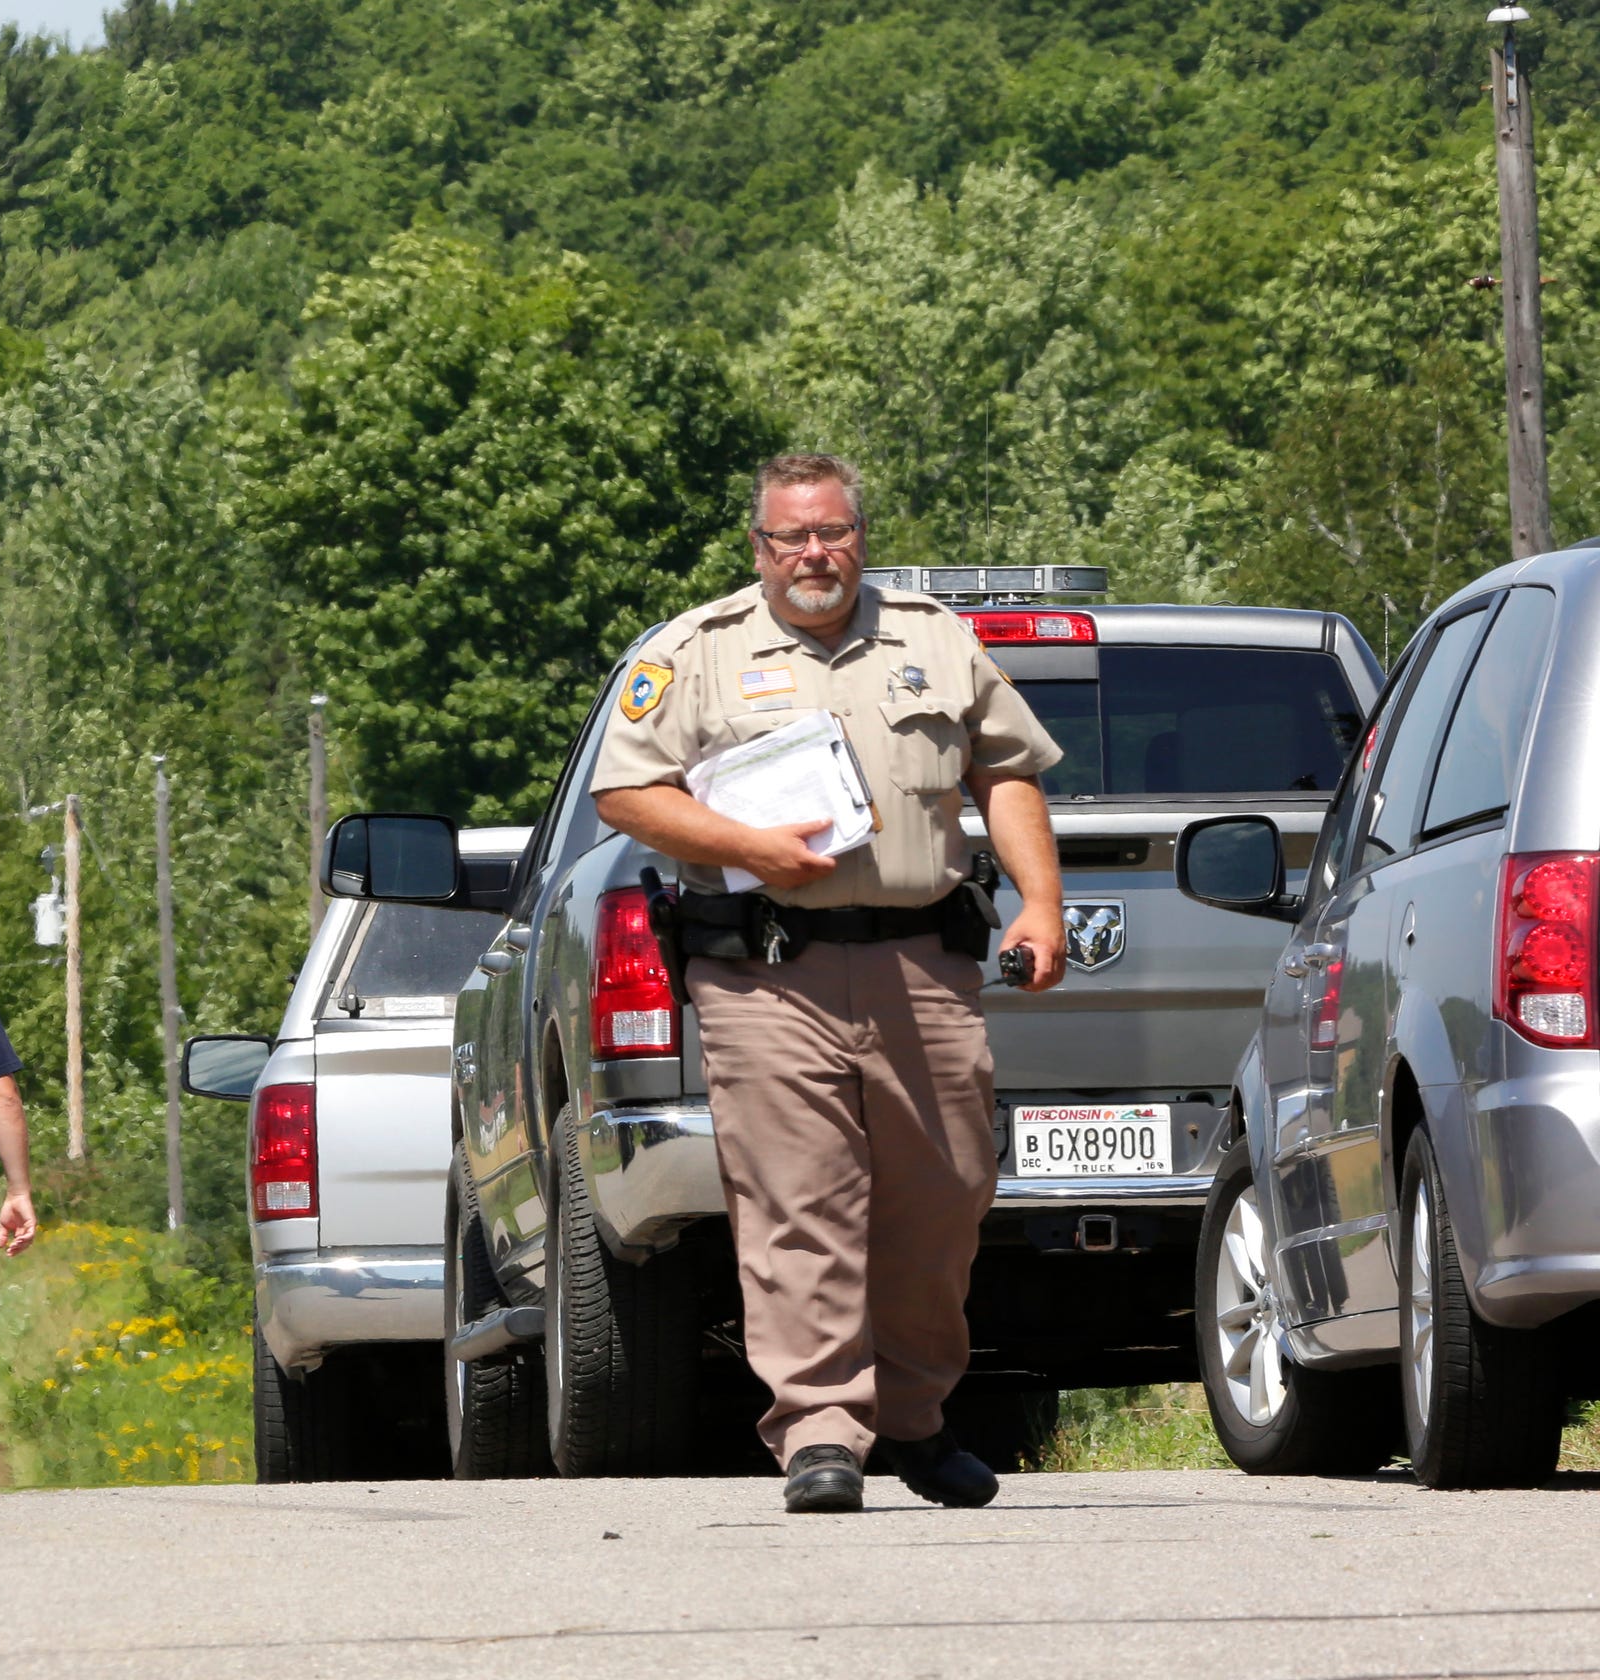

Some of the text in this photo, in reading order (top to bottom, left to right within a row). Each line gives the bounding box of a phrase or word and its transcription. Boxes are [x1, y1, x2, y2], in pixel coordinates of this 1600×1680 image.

[1022, 1109, 1102, 1121] WISCONSIN
[1026, 1126, 1155, 1161] B GX8900
[1022, 1158, 1042, 1168] DEC
[1073, 1164, 1115, 1173] TRUCK
